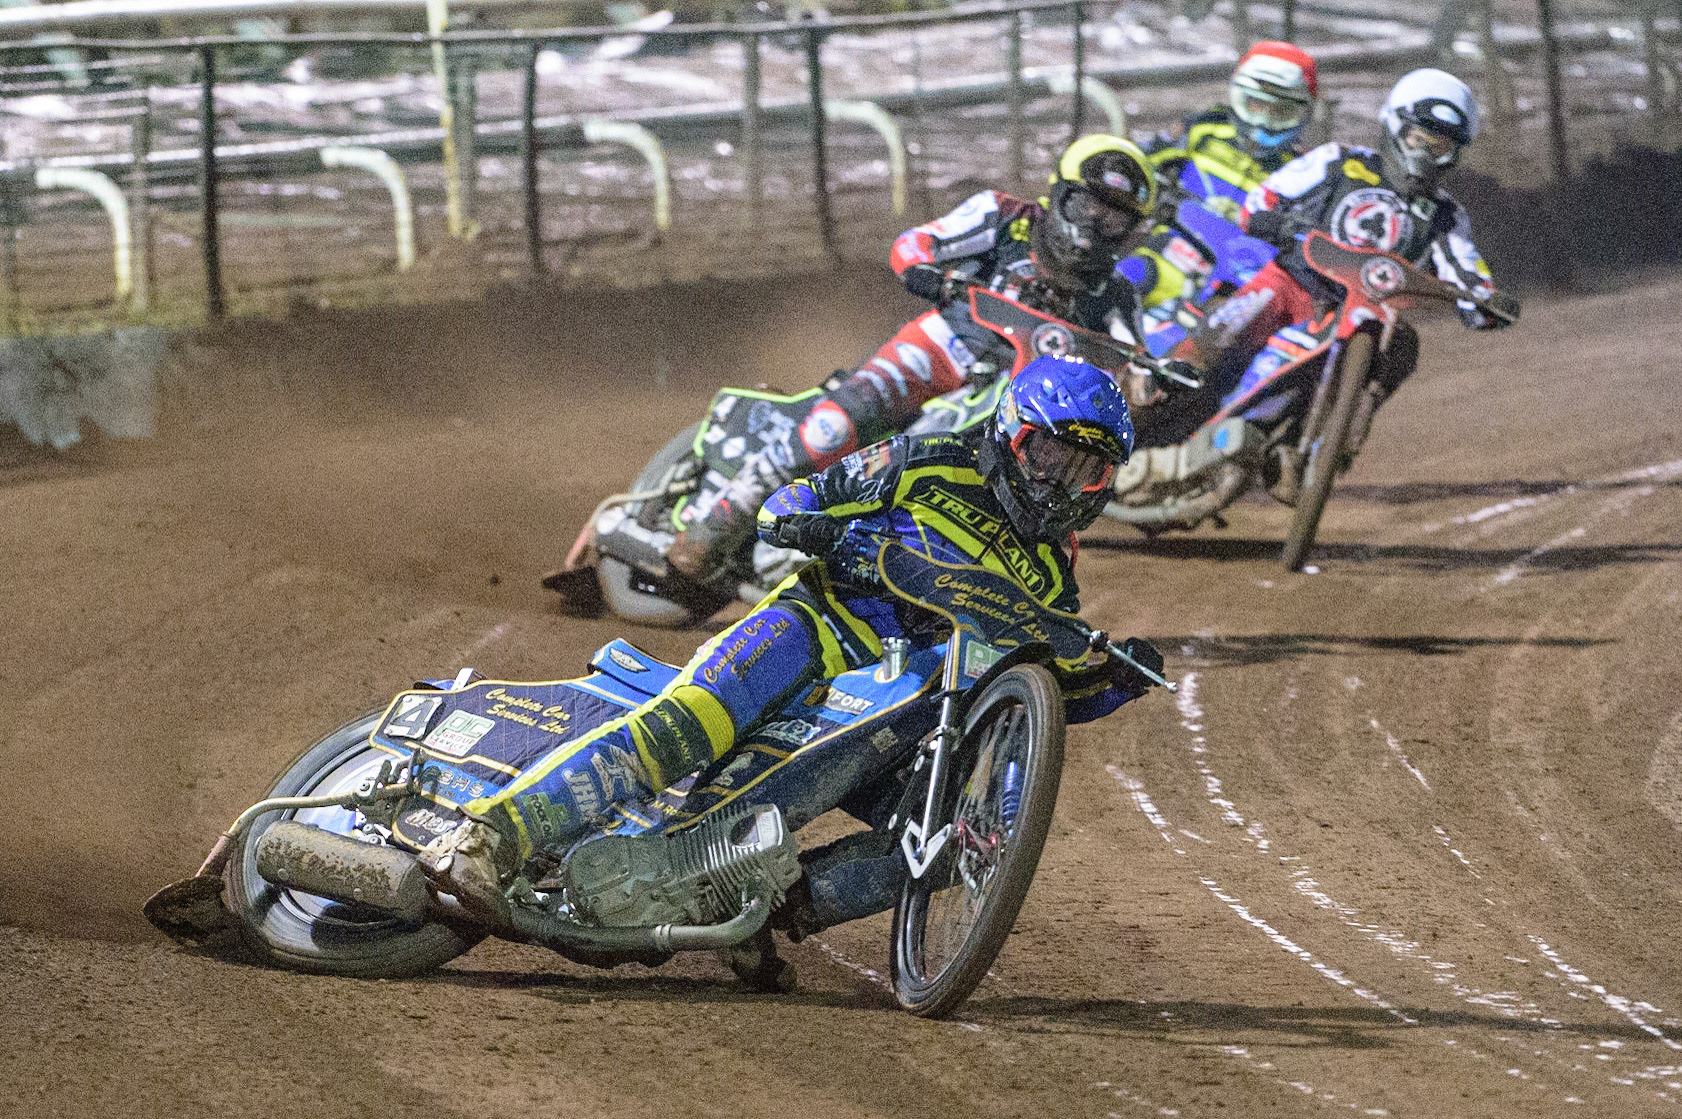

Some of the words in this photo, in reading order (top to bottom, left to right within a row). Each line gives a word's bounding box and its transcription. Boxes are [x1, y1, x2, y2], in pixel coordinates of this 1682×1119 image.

[930, 491, 981, 524] TRU
[703, 638, 749, 683] Complete
[744, 618, 767, 637] Car
[390, 697, 435, 736] 4
[485, 687, 544, 712] Complete
[542, 705, 571, 721] Car
[486, 703, 538, 727] Services
[434, 711, 493, 739] PC
[442, 731, 476, 745] GROUP
